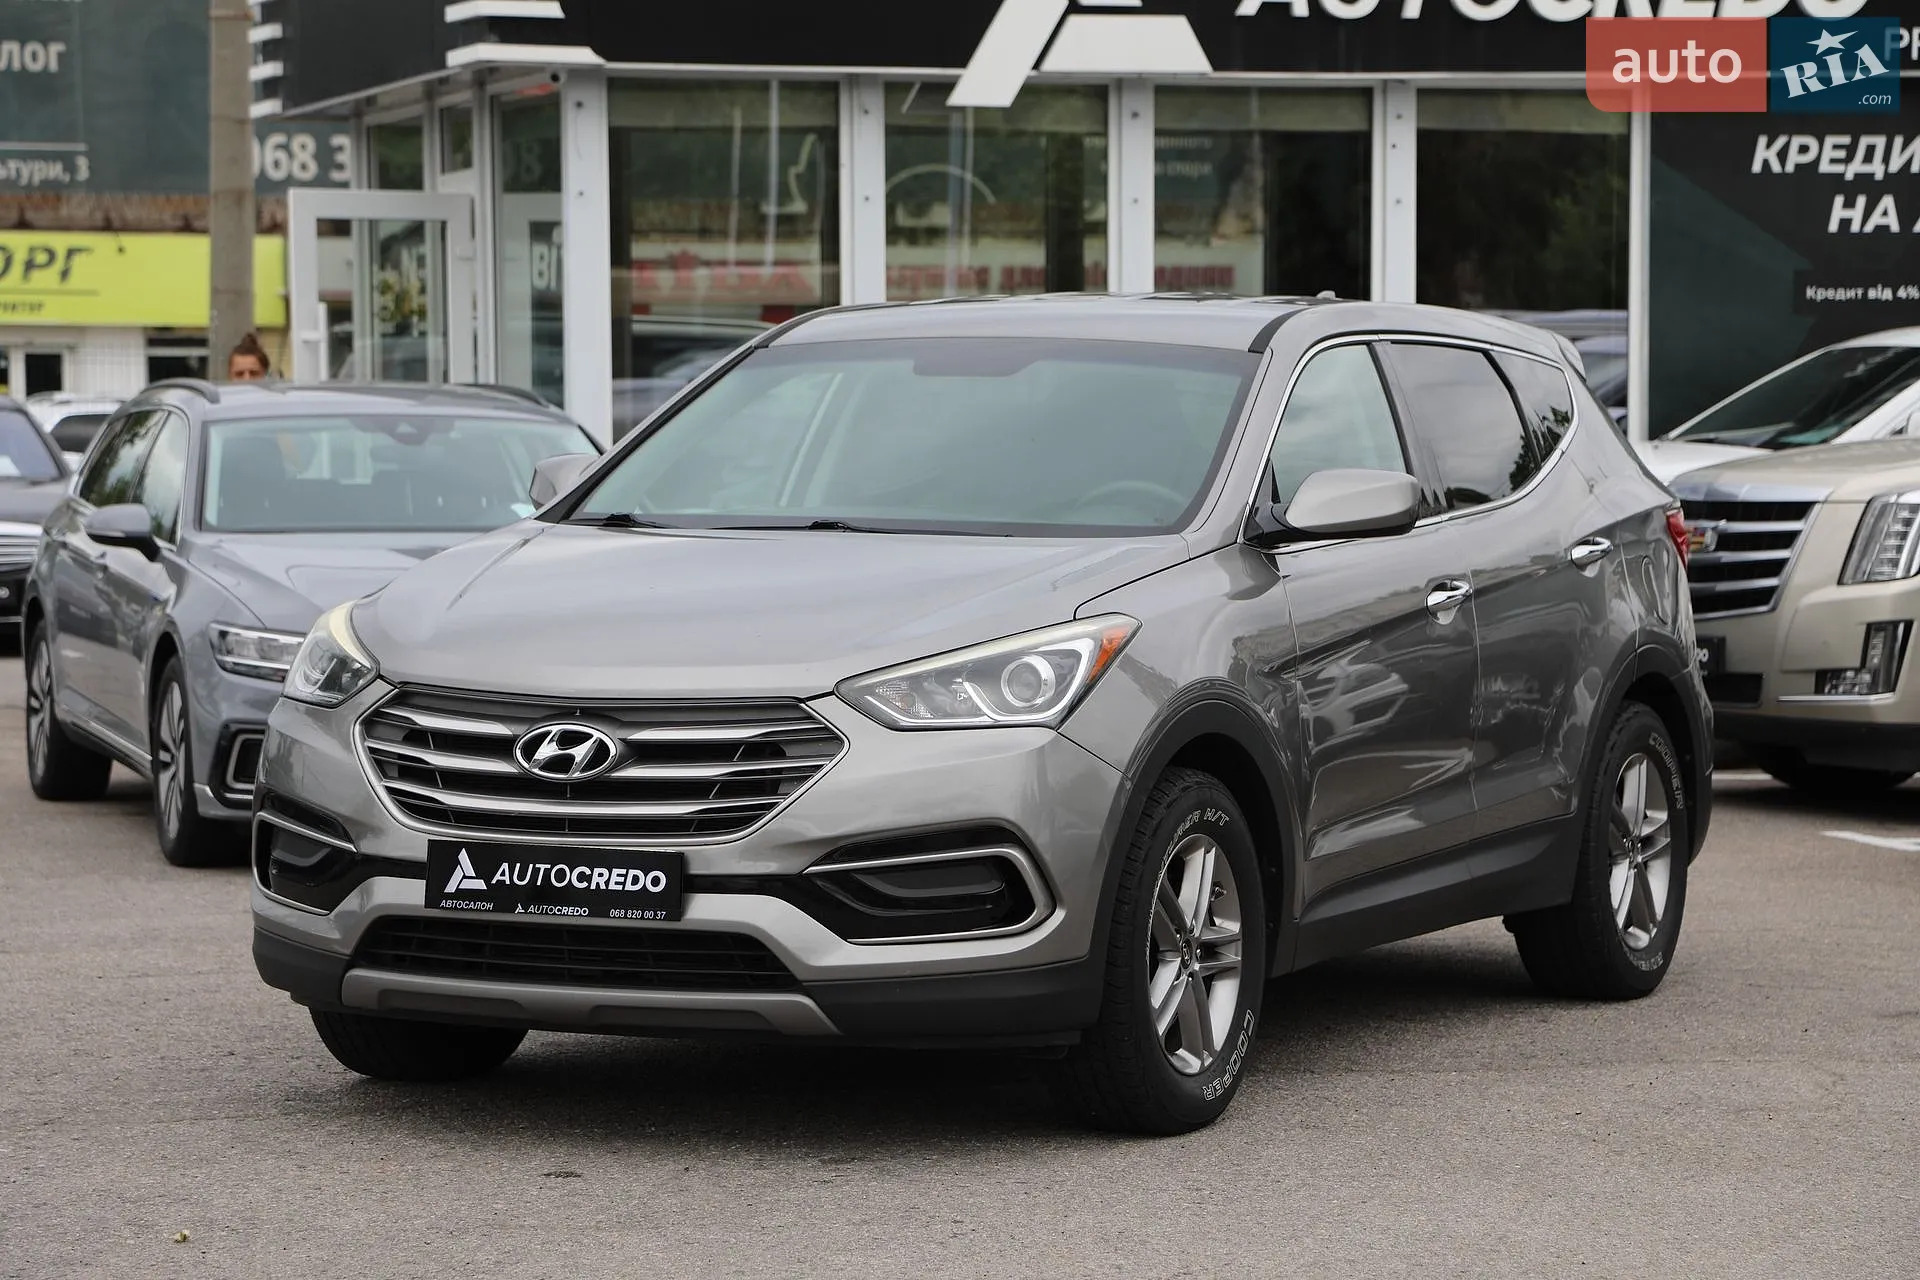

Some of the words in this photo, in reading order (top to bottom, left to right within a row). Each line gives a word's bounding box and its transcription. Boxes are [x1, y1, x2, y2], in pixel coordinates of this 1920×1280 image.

[74, 154, 91, 181] 3
[1751, 134, 1920, 181] КРЕДИ
[1827, 193, 1900, 233] НА
[1805, 285, 1864, 302] Кредит
[1867, 283, 1893, 301] від
[1896, 285, 1920, 300] 4%
[1649, 732, 1684, 809] COOPER
[1203, 808, 1230, 826] H/T
[491, 862, 667, 893] AUTOCREDO
[440, 899, 494, 911] АВТОСАЛОН
[527, 904, 589, 916] AUTOCREDO
[609, 908, 625, 918] 068
[626, 909, 642, 919] 820
[643, 910, 655, 919] 00
[655, 911, 667, 920] 37
[1203, 1009, 1255, 1101] COOPER
